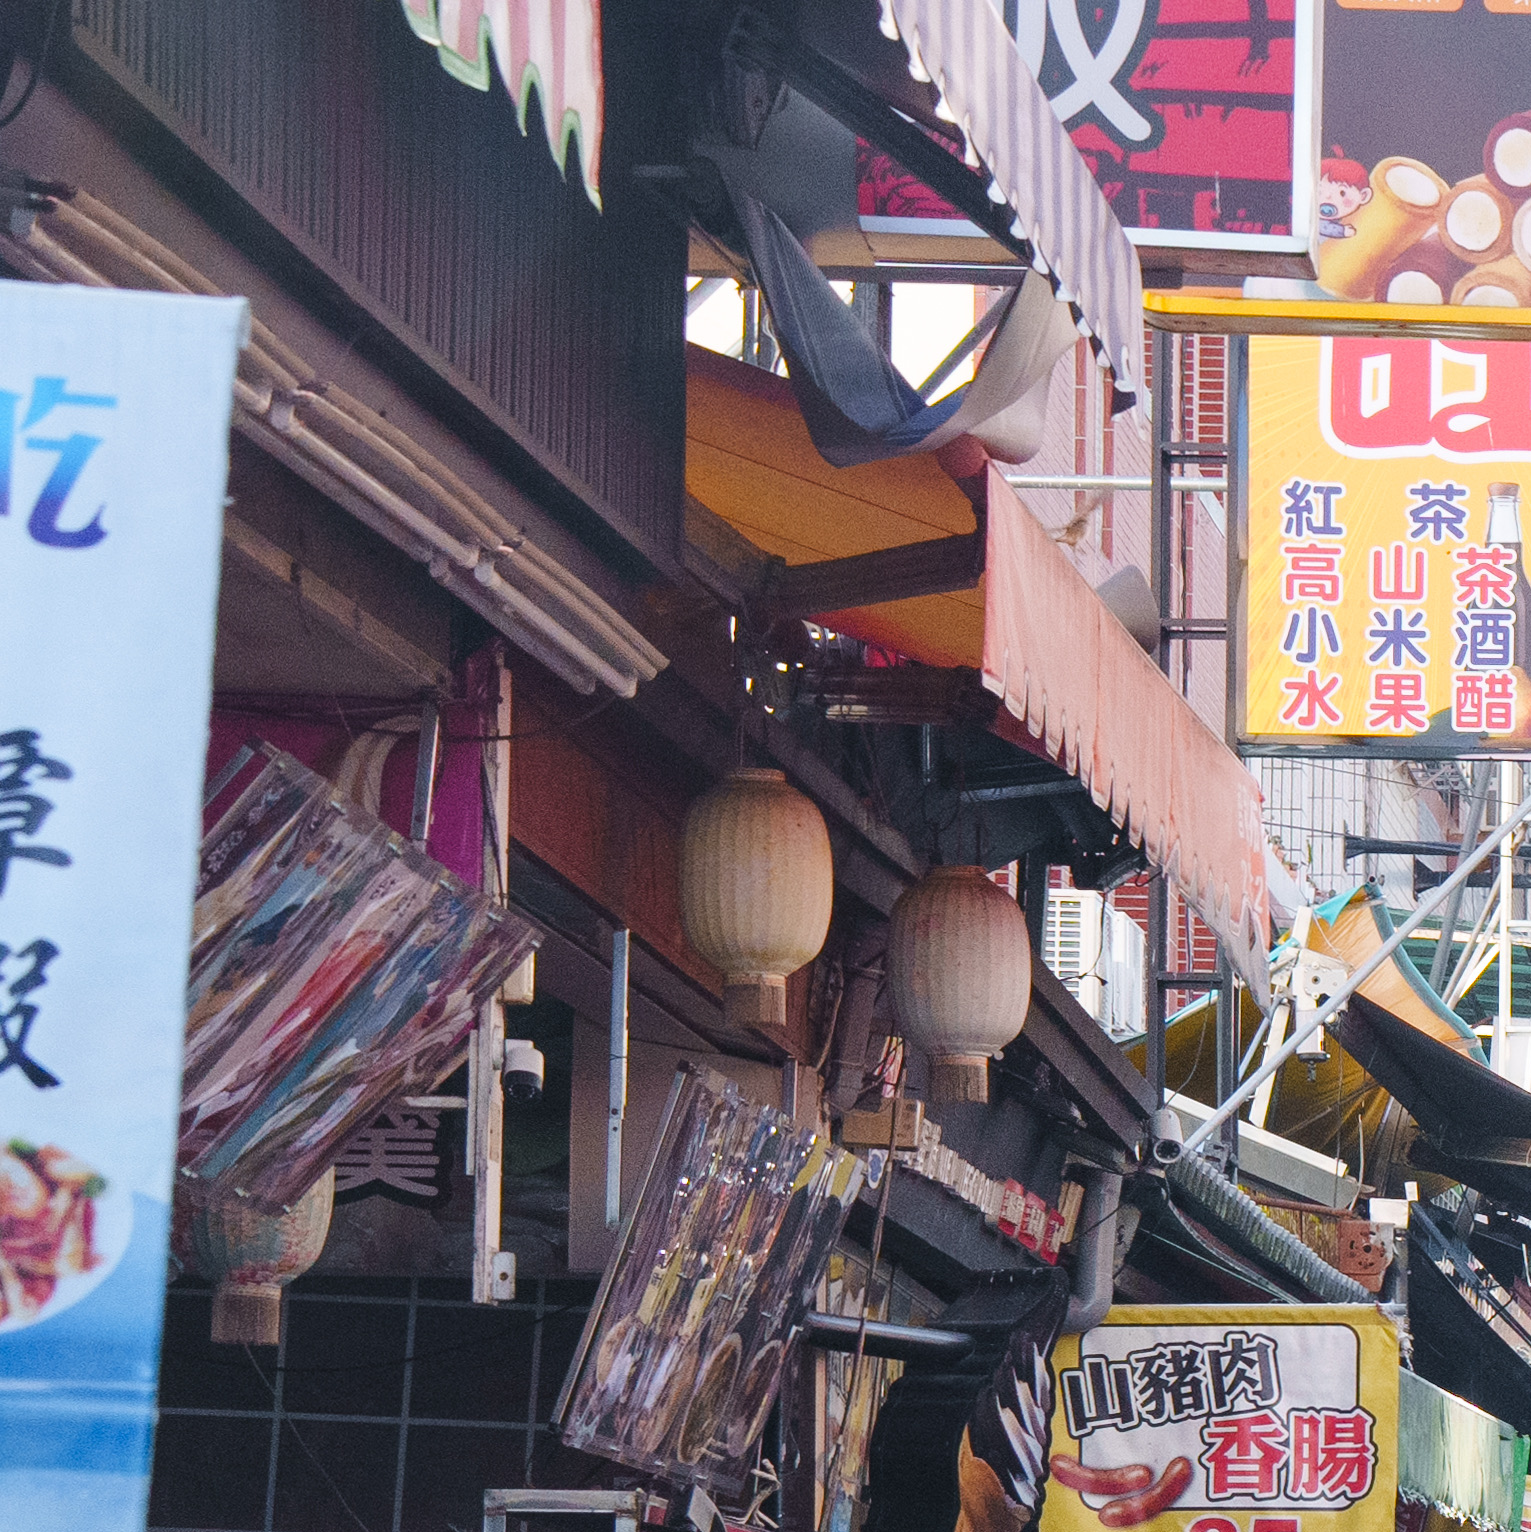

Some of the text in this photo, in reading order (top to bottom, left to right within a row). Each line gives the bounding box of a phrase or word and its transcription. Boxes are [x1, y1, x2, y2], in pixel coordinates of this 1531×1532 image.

[1282, 480, 1470, 541] 紅茶
[1282, 545, 1516, 603] 高山茶
[1282, 608, 1516, 668] 小米酒
[1282, 672, 1516, 732] 水果醋
[1062, 1332, 1282, 1436] 山豬肉
[1202, 1409, 1376, 1500] 香腸
